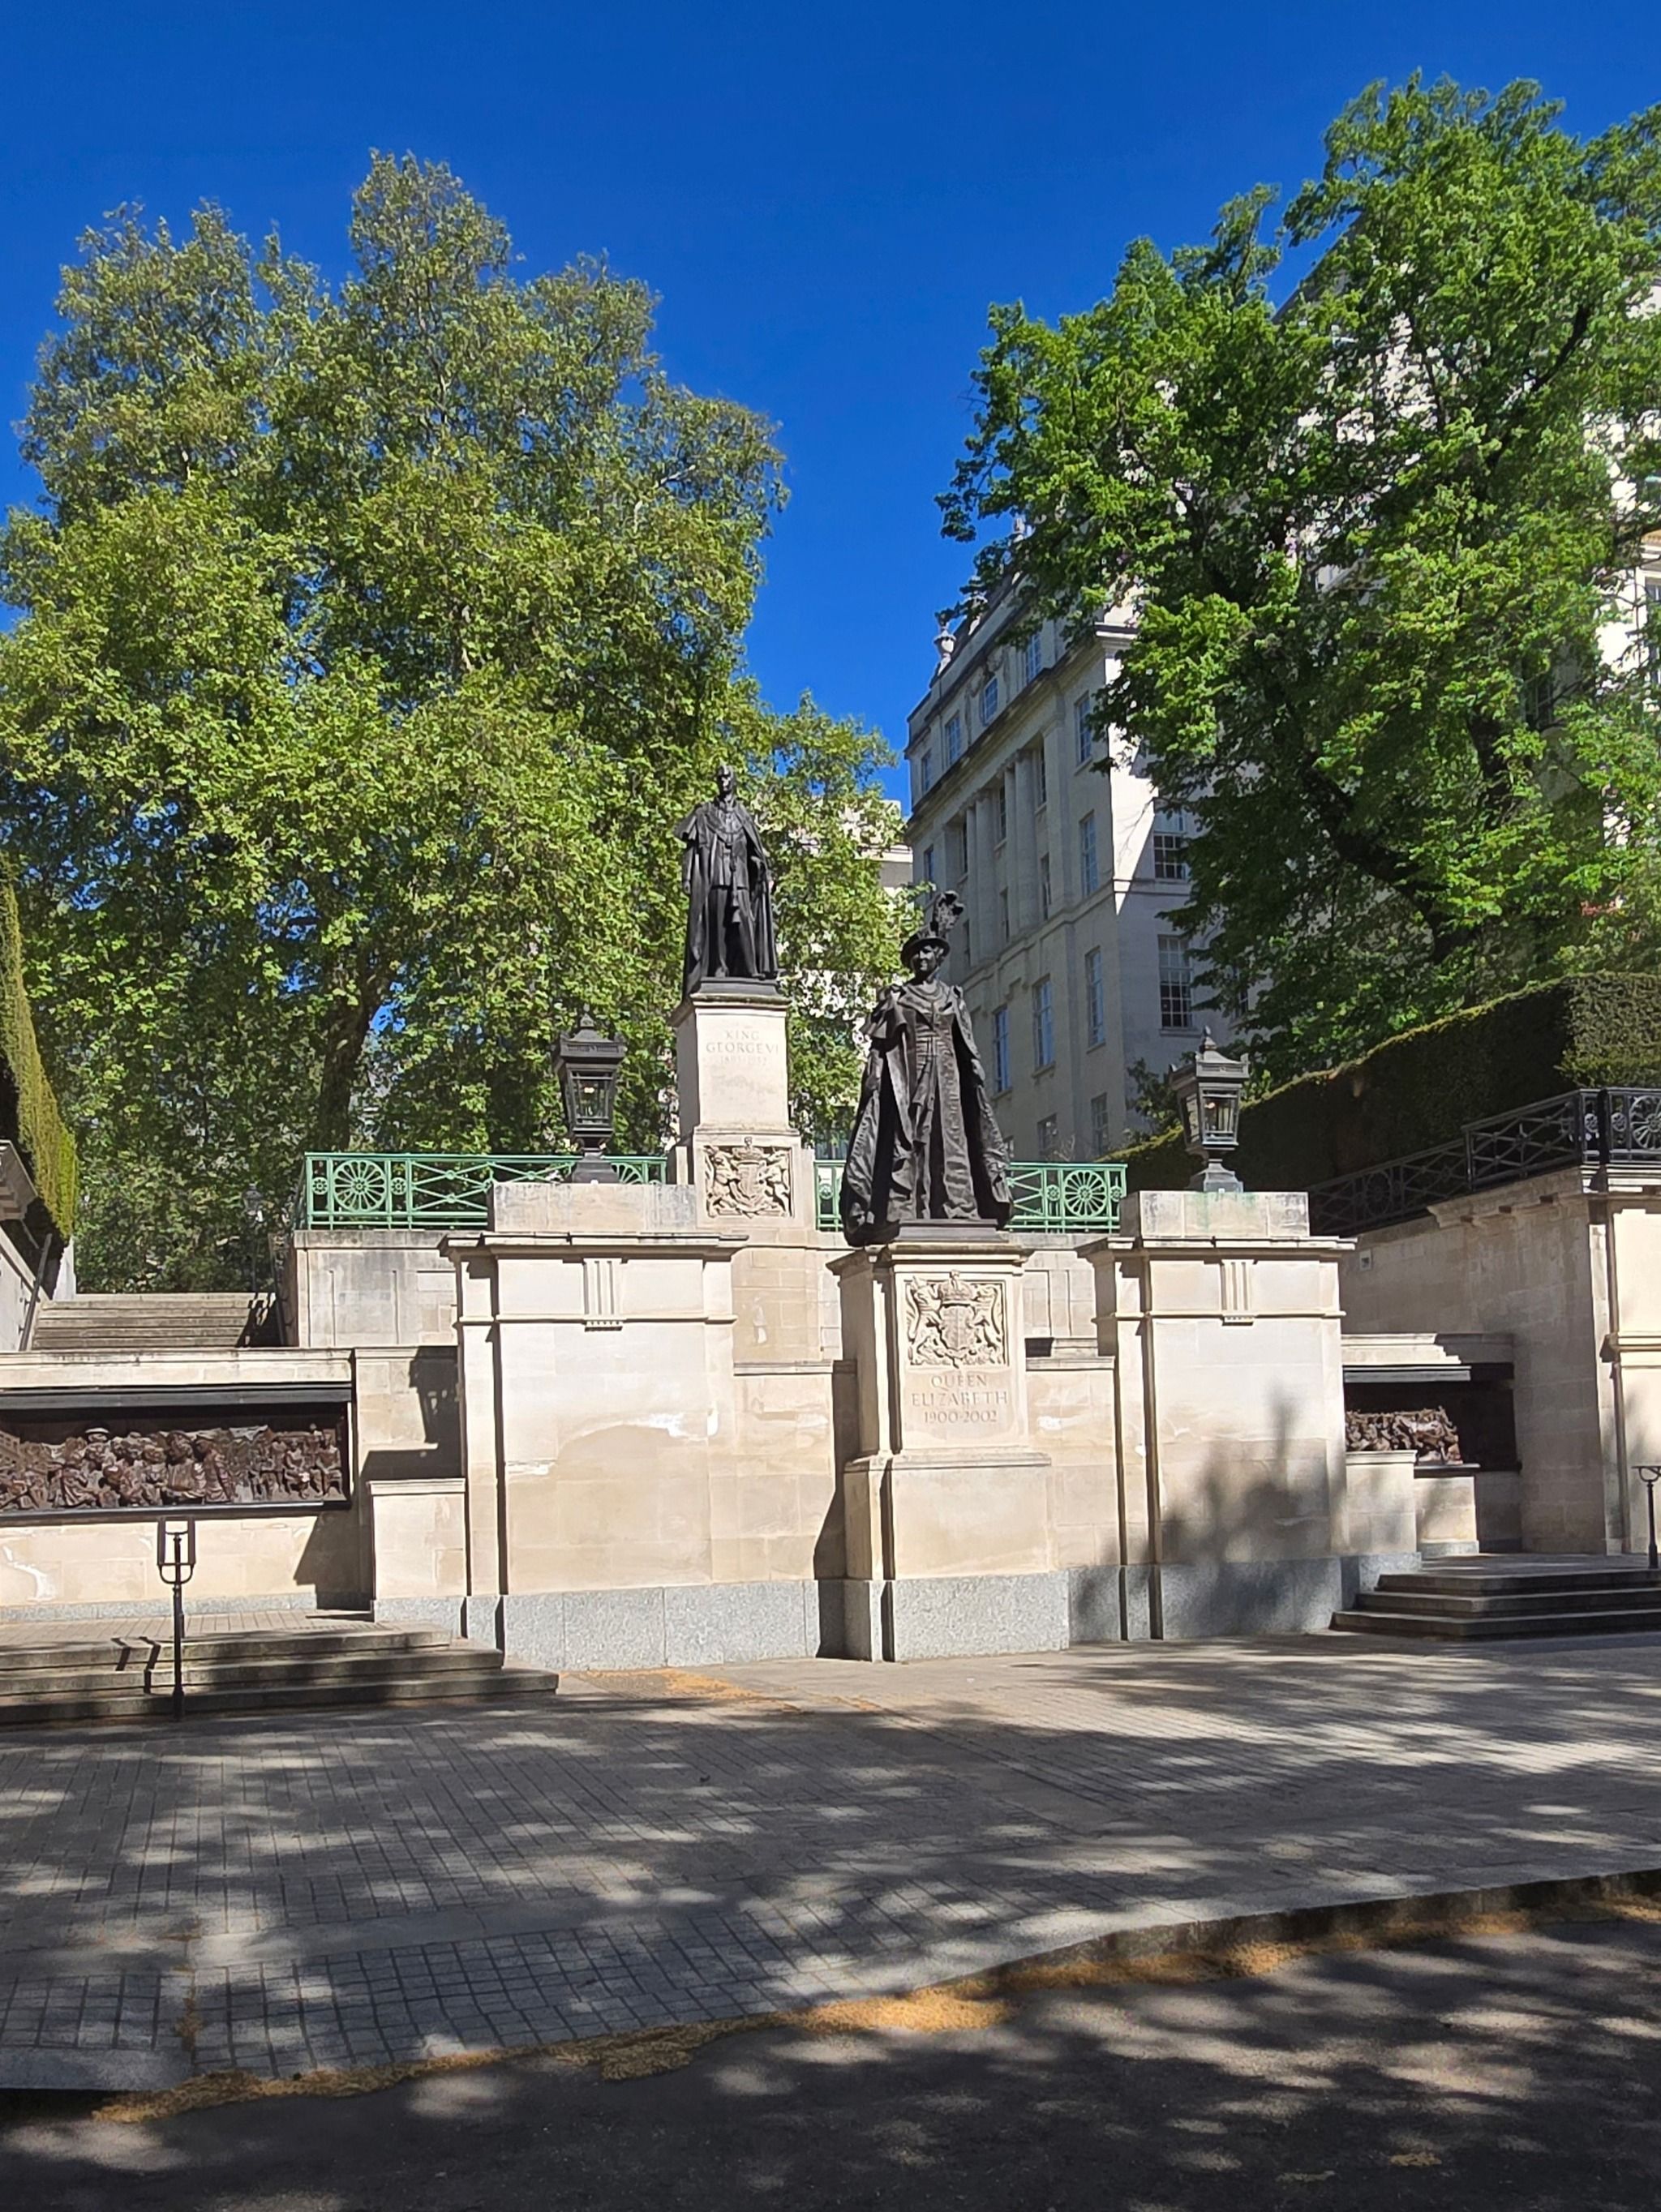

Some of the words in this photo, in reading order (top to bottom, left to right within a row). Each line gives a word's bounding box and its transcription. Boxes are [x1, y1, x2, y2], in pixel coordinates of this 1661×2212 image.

[724, 1030, 760, 1040] KING
[706, 1042, 763, 1054] GEORGE
[765, 1043, 779, 1055] VI
[931, 1374, 987, 1391] QUEEN
[912, 1391, 1008, 1407] ELIZABETH
[925, 1410, 997, 1424] 1900-2002
